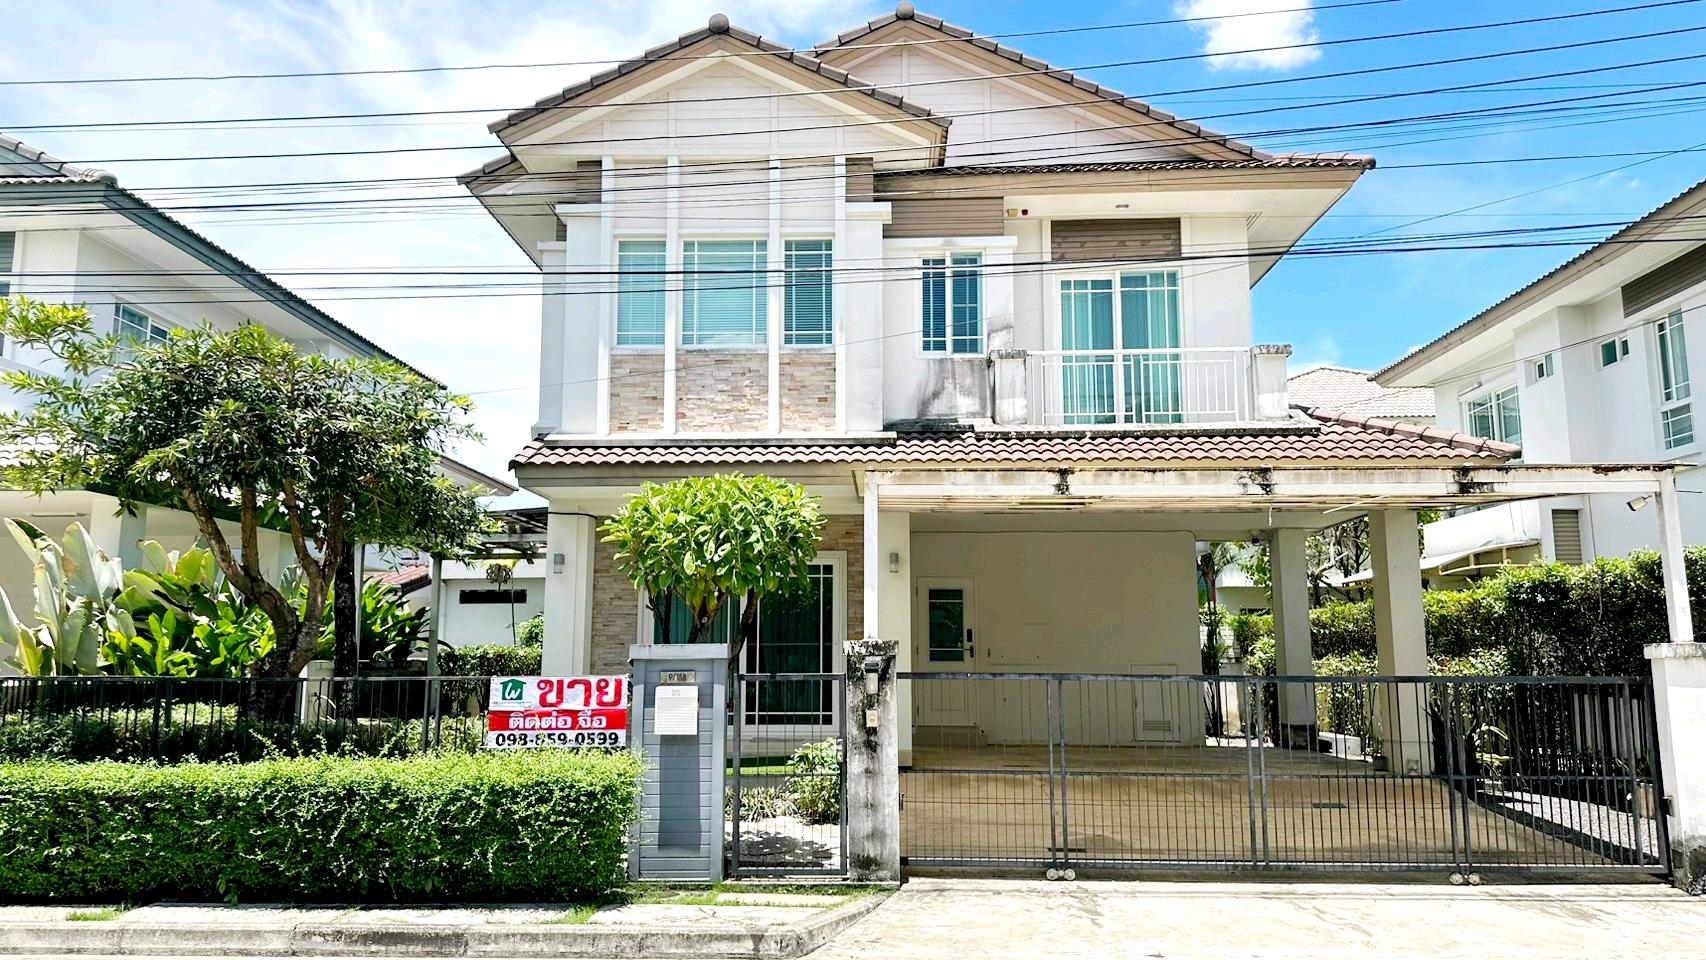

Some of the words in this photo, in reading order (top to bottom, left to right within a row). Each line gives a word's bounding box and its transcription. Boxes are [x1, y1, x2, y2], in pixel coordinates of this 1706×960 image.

[537, 678, 623, 708] ขาย
[508, 711, 572, 729] ติดต่อ
[495, 732, 619, 747] 098-859-0599
